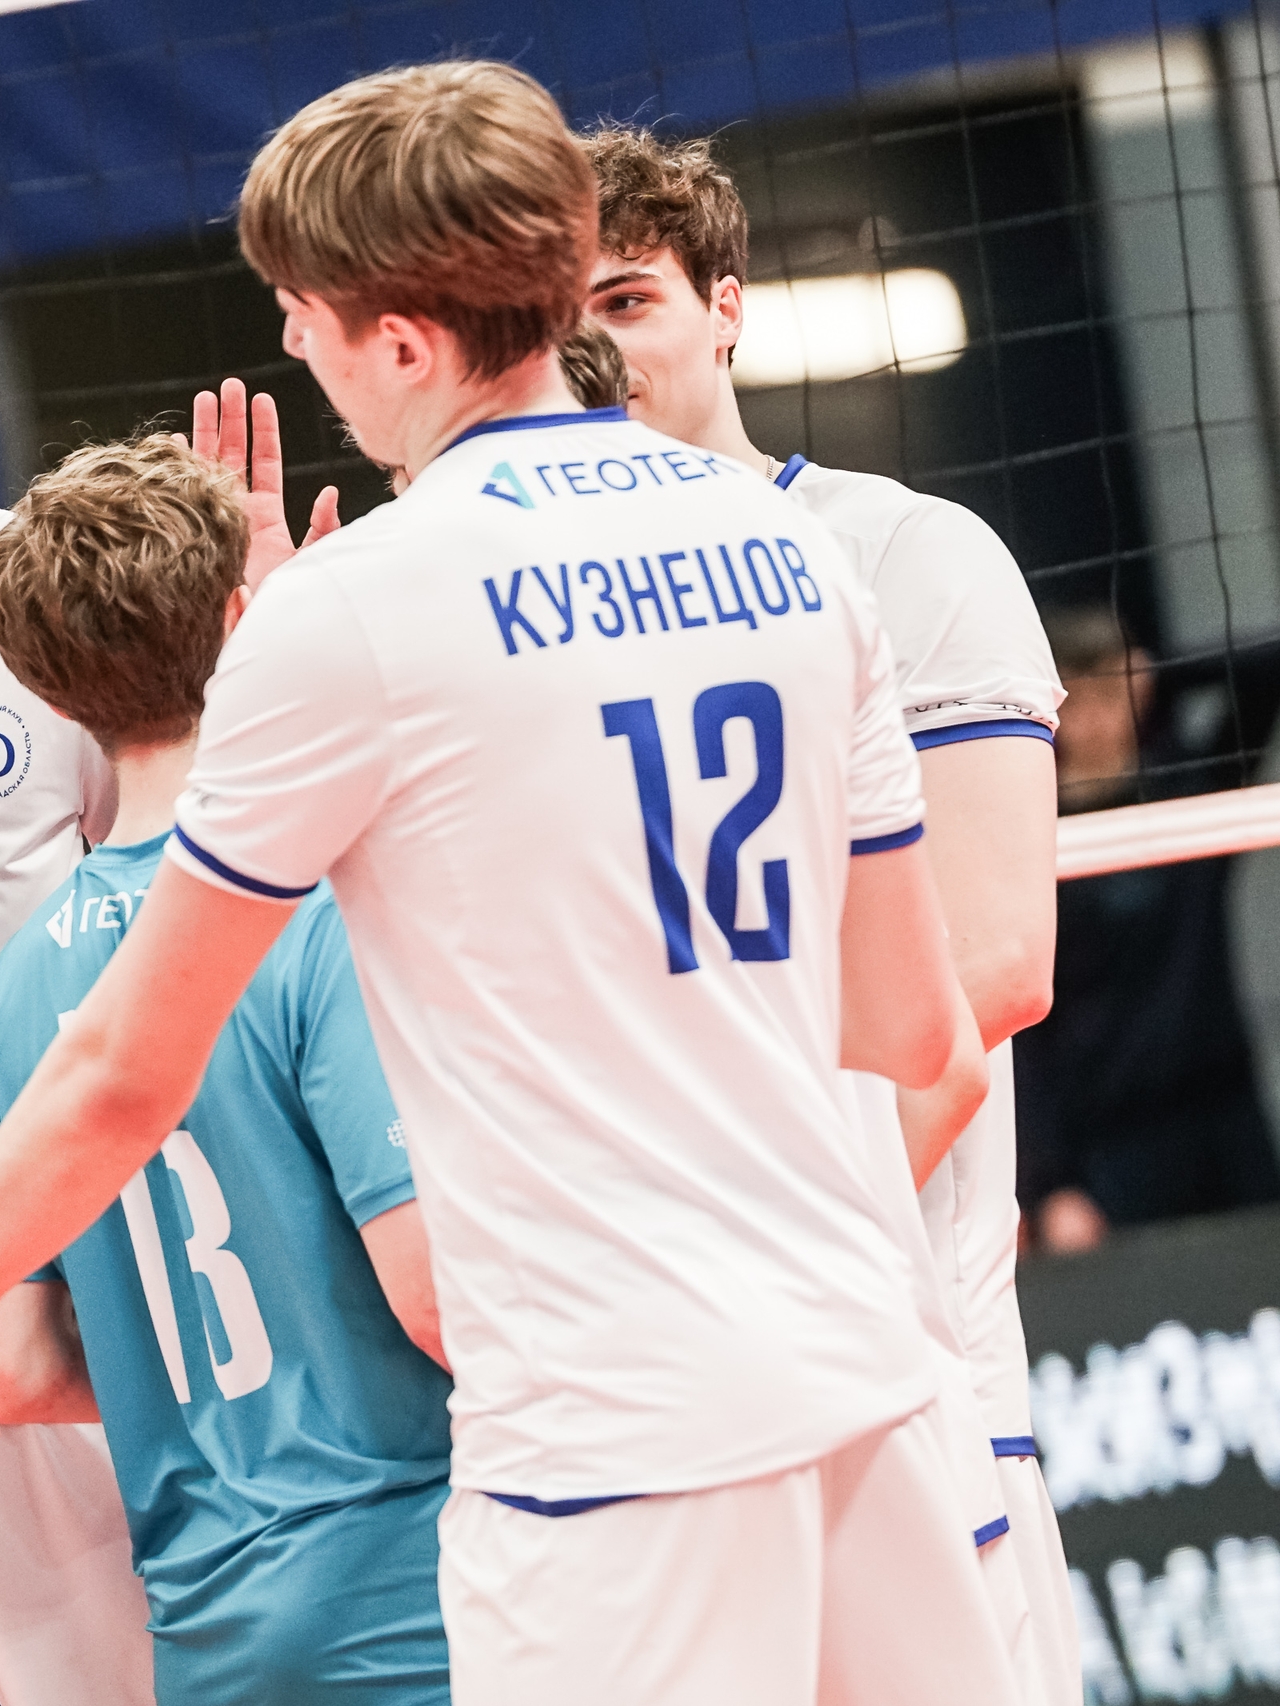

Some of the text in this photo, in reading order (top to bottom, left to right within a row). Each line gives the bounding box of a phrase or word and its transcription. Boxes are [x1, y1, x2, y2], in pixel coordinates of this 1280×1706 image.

[483, 538, 822, 656] КУЗНЕЦОВ
[600, 681, 791, 975] 12
[120, 1130, 273, 1404] 13
